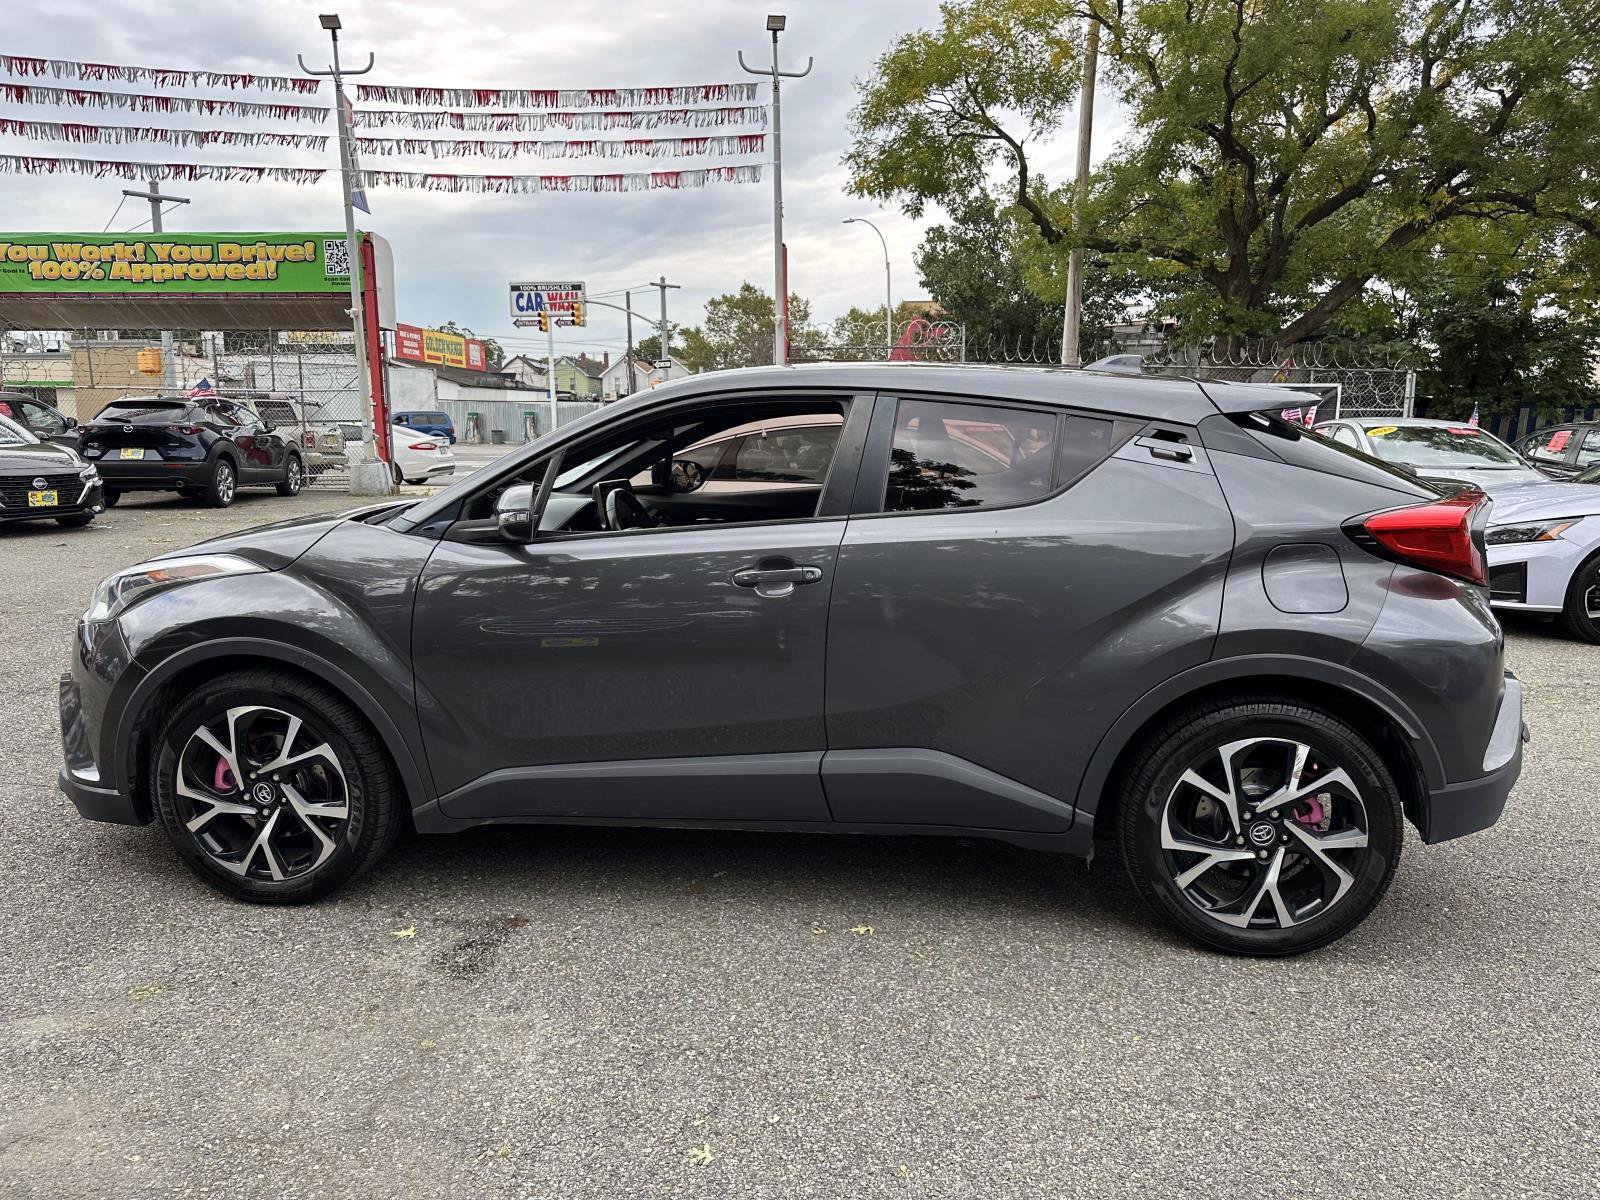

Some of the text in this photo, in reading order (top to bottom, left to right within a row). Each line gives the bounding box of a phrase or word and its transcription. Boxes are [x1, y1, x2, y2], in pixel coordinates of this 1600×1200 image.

[51, 241, 145, 262] Work!
[148, 242, 213, 262] You
[218, 241, 316, 262] Drive!
[28, 260, 278, 283] 100% Approved!
[515, 292, 579, 312] CAR WASH
